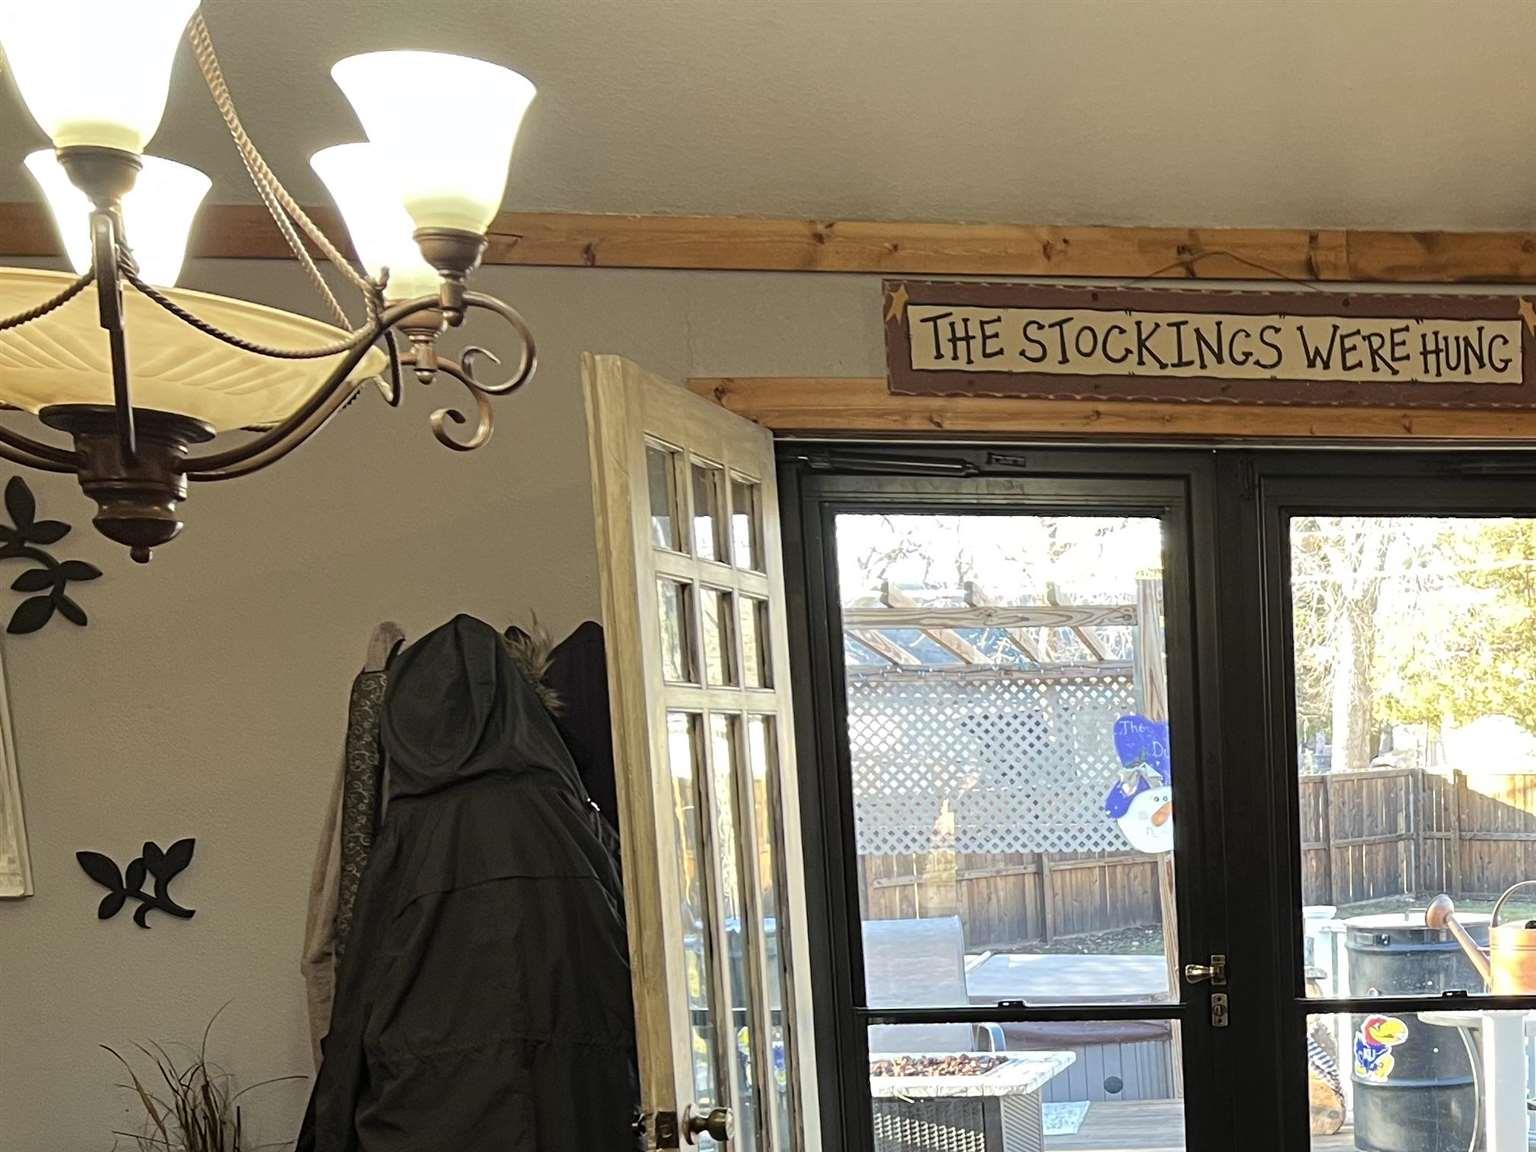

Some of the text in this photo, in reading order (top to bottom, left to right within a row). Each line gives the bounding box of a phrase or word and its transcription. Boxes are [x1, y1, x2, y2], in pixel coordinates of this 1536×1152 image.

[919, 312, 1513, 378] THE STOCKINGS WERE HUNG
